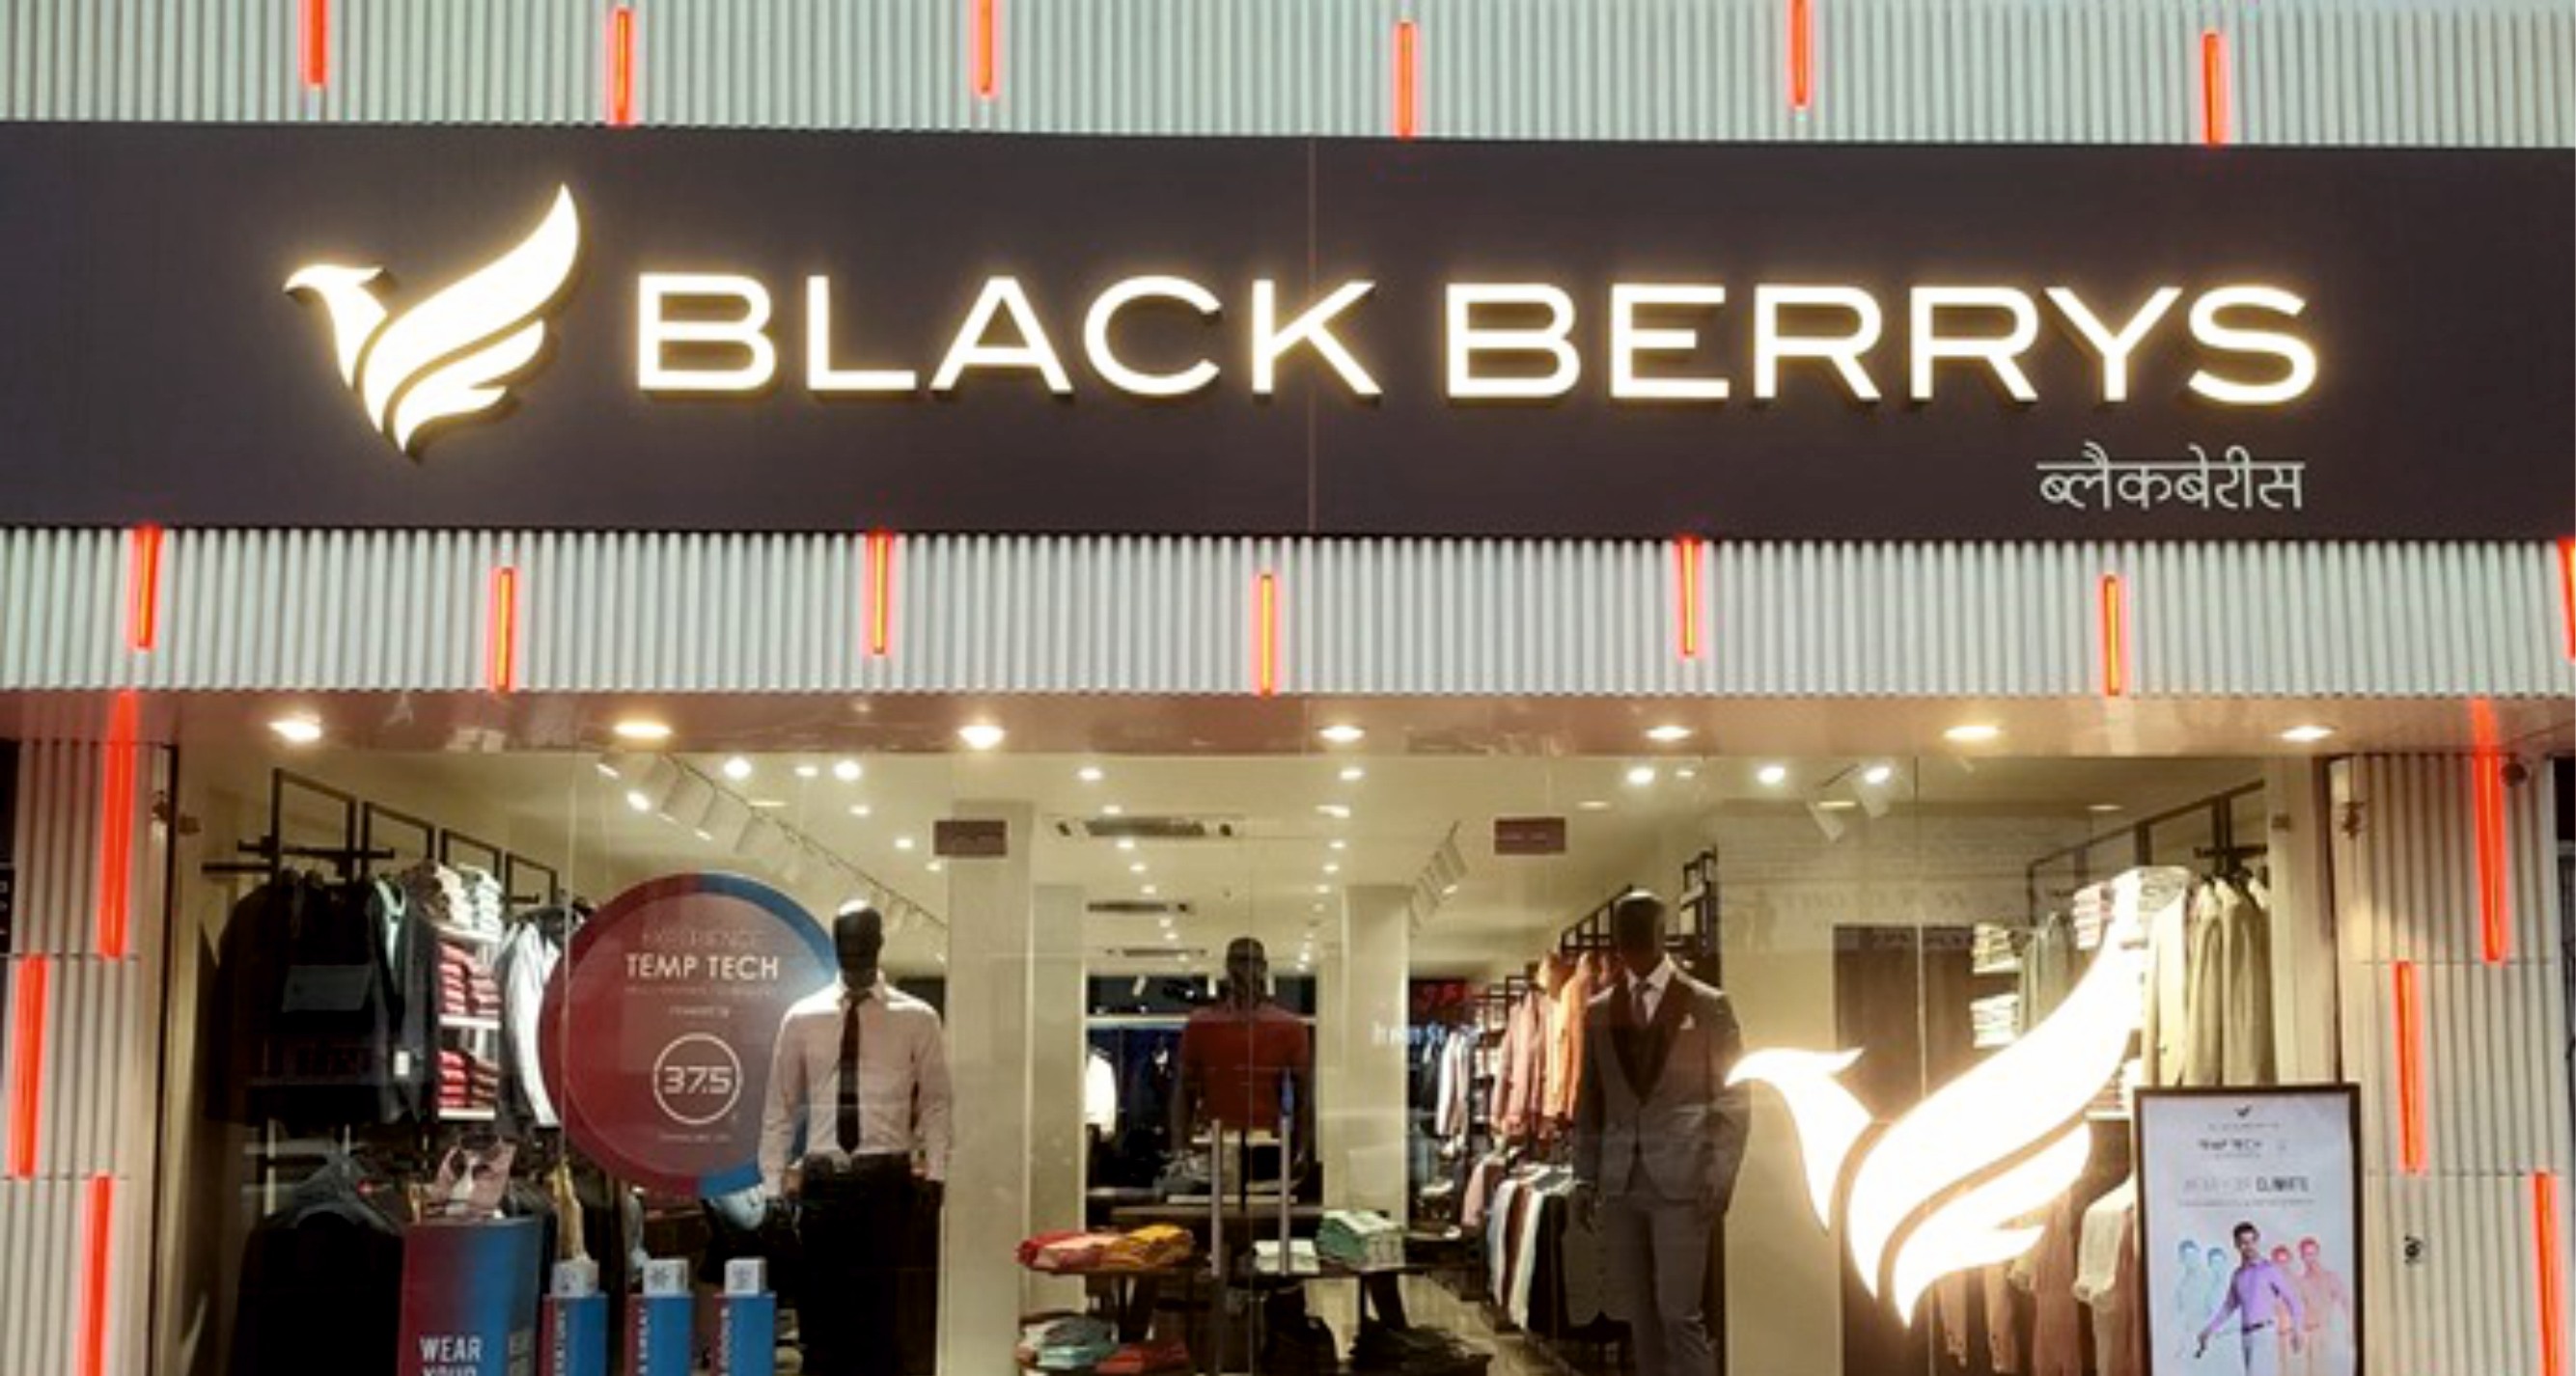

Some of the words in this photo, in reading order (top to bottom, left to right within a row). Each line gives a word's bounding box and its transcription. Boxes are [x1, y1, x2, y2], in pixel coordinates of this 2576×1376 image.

[636, 272, 1383, 397] BLACK
[1445, 283, 2318, 404] BERRYS
[2036, 441, 2306, 509] ब्लैकबेरीस
[625, 952, 699, 980] TEMP
[706, 954, 780, 981] TECH
[419, 1334, 483, 1362] WEAR
